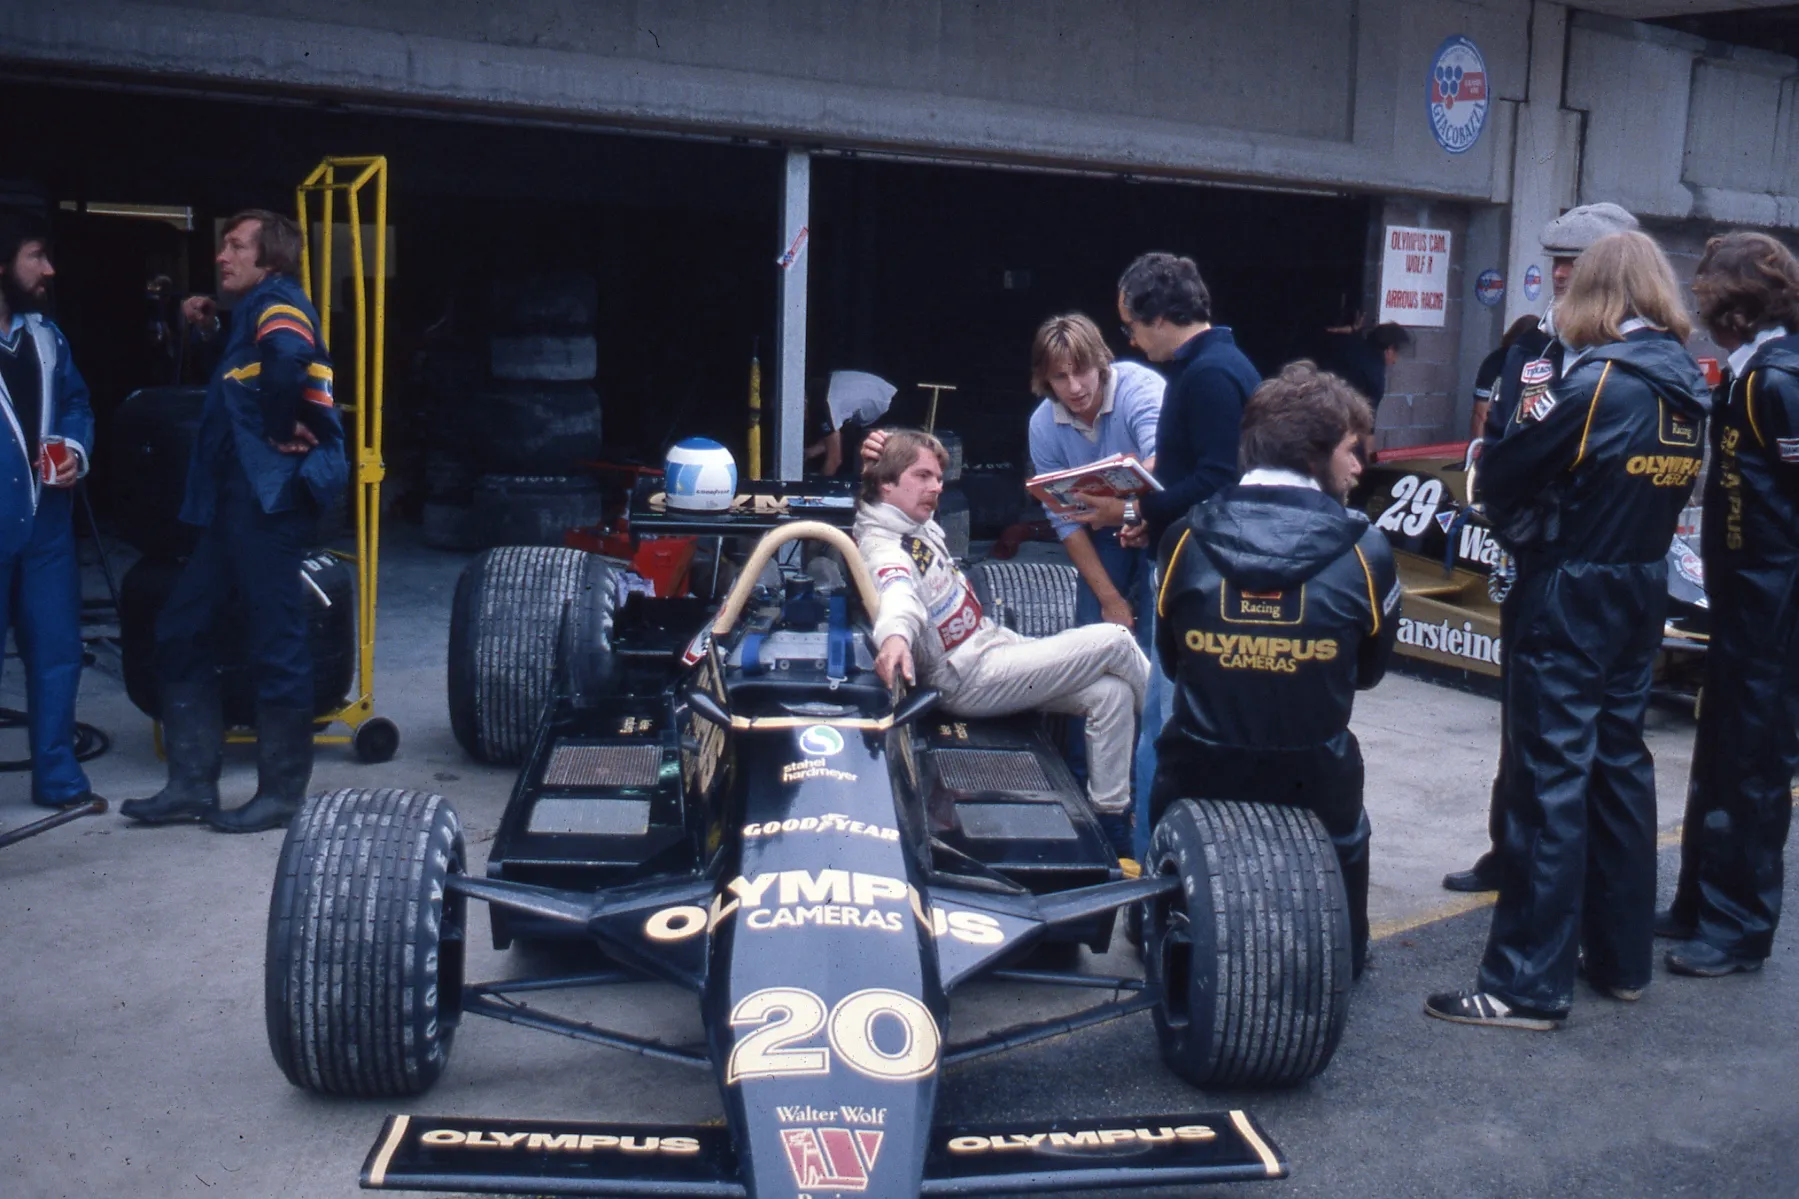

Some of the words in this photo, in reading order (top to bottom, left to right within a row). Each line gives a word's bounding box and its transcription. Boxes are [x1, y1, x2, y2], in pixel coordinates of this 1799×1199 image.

[1432, 102, 1484, 145] GIACOBAZZI
[1391, 230, 1427, 252] OLYMPUS
[1406, 254, 1425, 274] WOLF
[1385, 289, 1418, 309] ARROWS
[1376, 475, 1442, 536] 29
[1241, 601, 1281, 618] Racing
[1185, 629, 1338, 661] OLYMPUS
[1219, 653, 1297, 673] CAMERAS
[743, 812, 900, 842] GOODYEAR
[645, 869, 1005, 945] OLYMPUS
[746, 905, 904, 932] CAMERAS
[727, 986, 942, 1085] 20
[776, 1105, 838, 1122] Walter
[840, 1105, 887, 1124] Wolf
[420, 1129, 701, 1152] OLYMPUS
[947, 1125, 1217, 1151] OLYMPUS
